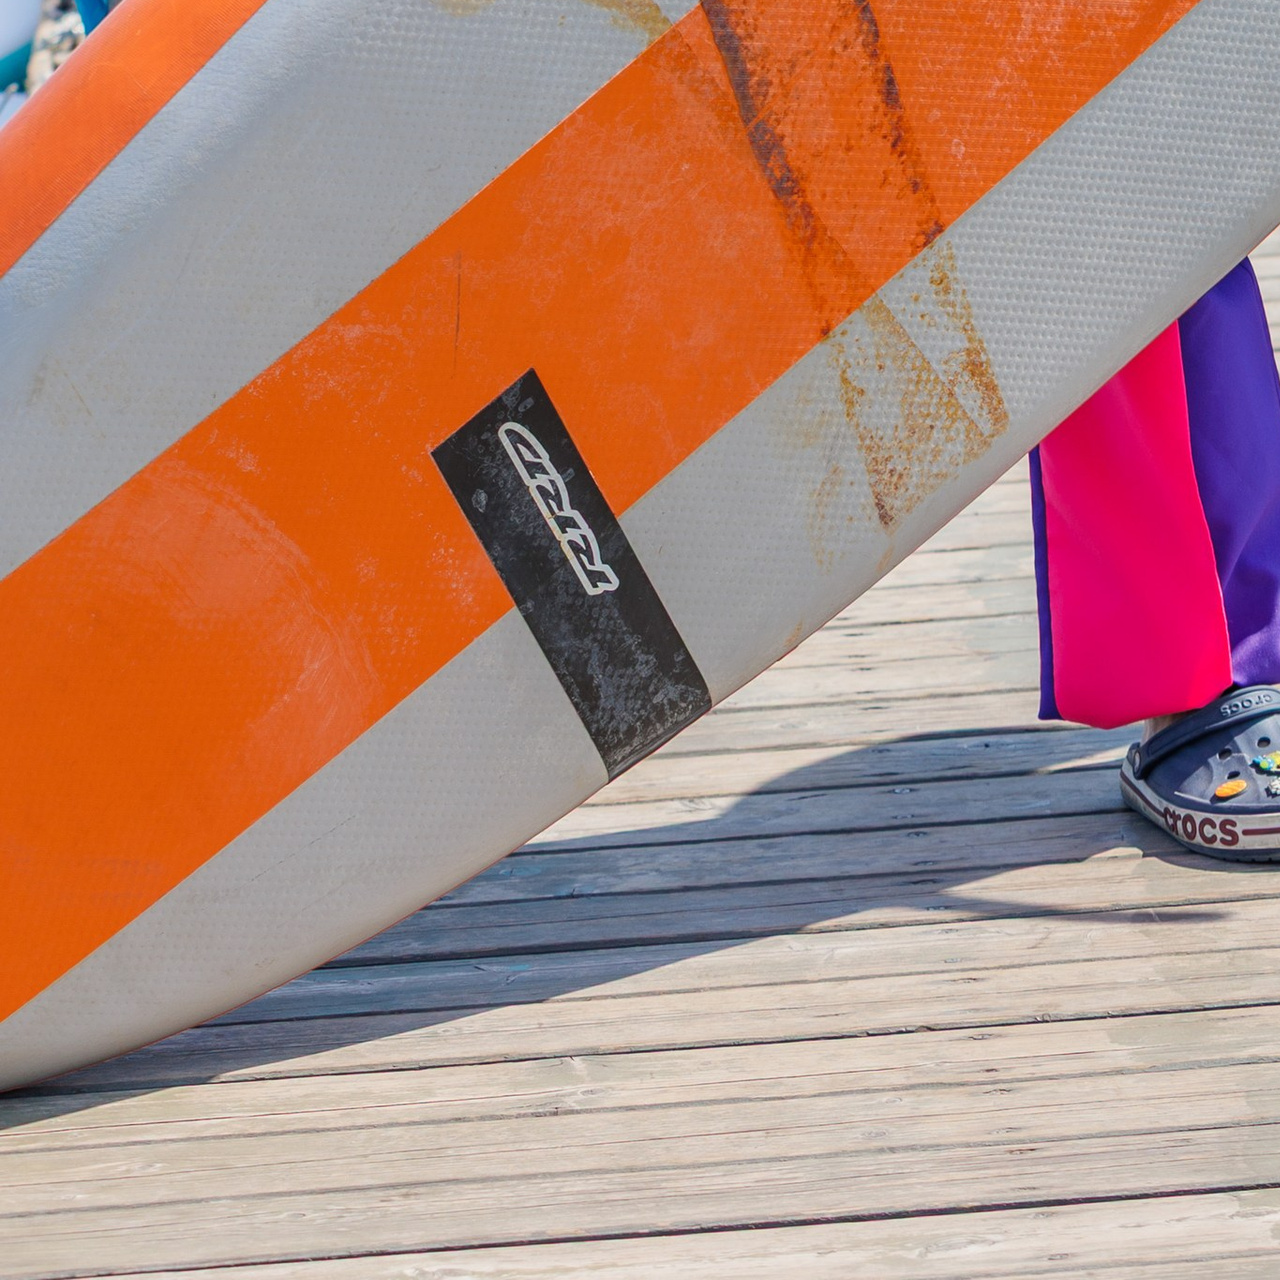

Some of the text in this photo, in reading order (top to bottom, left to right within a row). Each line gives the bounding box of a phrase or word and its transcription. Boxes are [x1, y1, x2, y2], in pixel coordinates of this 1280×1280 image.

[498, 421, 620, 596] RRD
[1219, 692, 1274, 718] crocs
[1162, 804, 1241, 848] crocs
